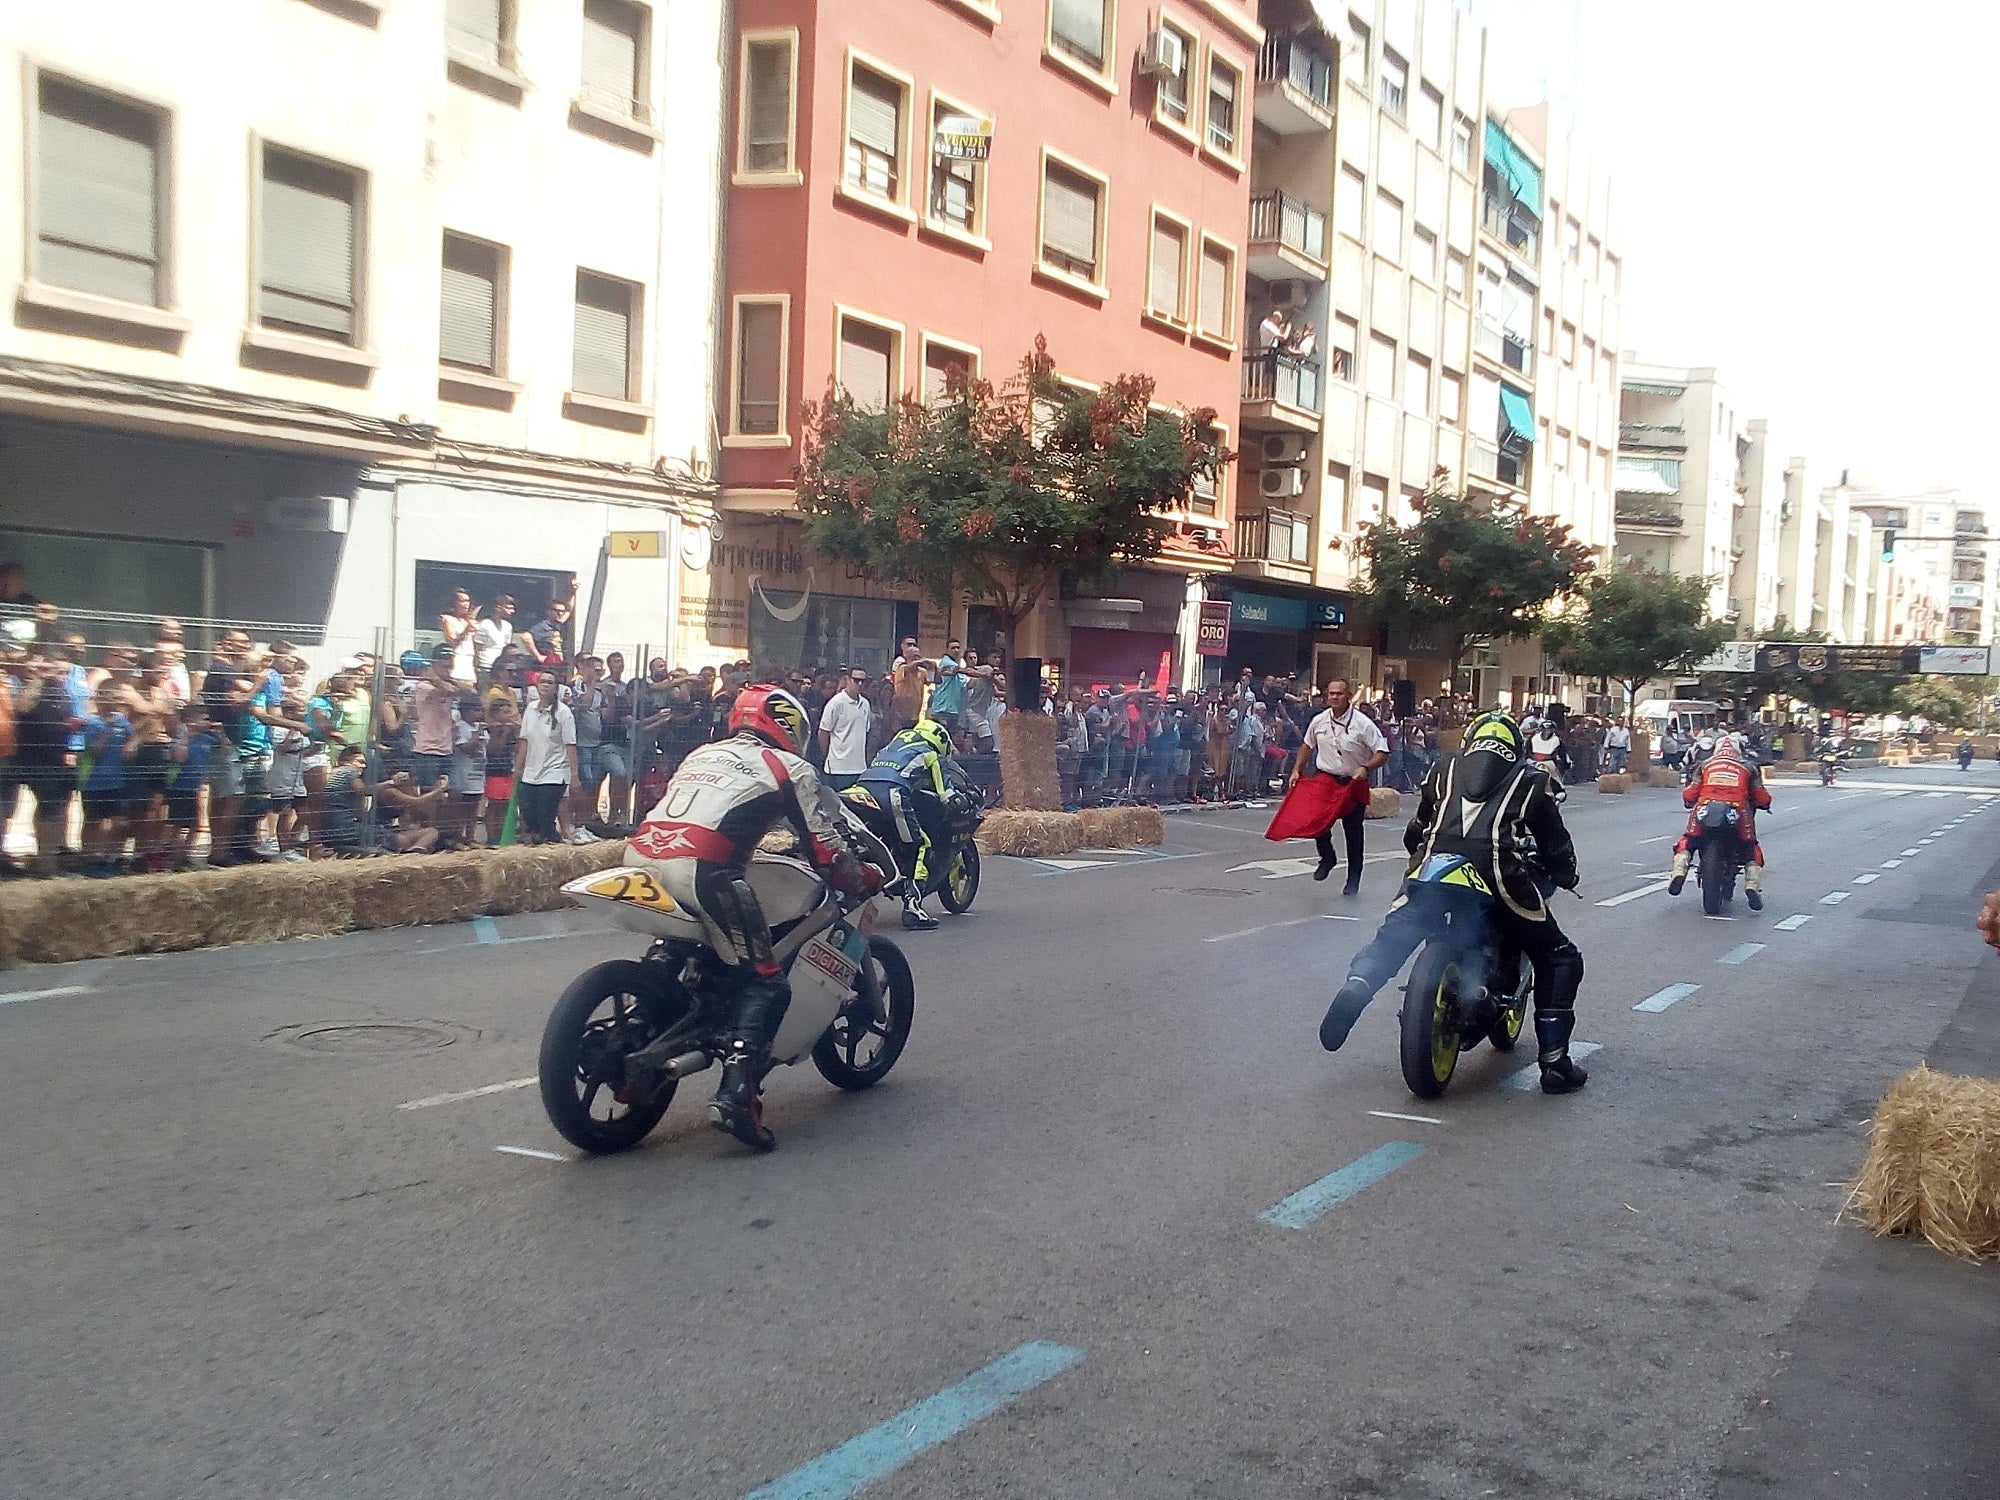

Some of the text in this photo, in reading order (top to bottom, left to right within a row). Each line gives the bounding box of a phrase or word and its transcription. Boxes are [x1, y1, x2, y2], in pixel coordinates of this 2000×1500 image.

[710, 537, 803, 576] orpréndele
[1241, 605, 1268, 620] Sabadell
[1200, 626, 1225, 640] ORO
[612, 871, 661, 902] 23
